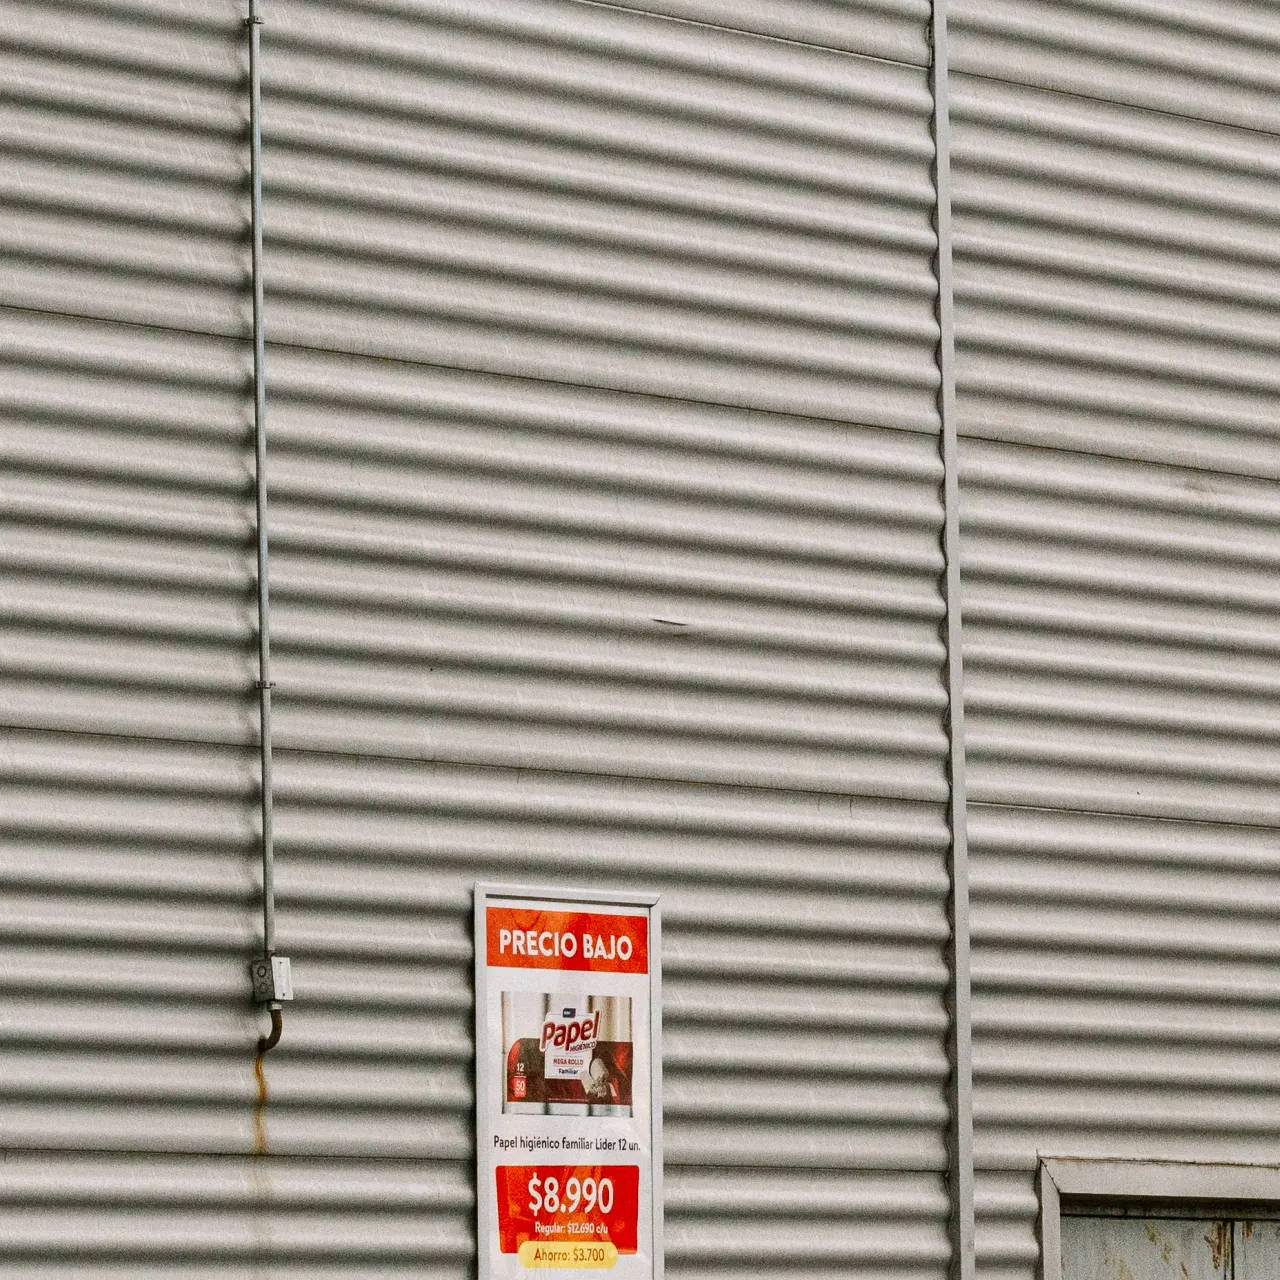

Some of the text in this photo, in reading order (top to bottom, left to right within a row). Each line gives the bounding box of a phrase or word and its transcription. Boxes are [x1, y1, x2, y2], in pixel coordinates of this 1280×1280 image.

[499, 929, 633, 961] PRECIO BAJO
[542, 1010, 600, 1051] Papel
[517, 1063, 525, 1072] 12
[493, 1135, 641, 1153] Papel higiénico familiar Lider 12 un.
[528, 1172, 614, 1216] $8.990
[535, 1222, 608, 1236] Regular: $12.690 c/u
[534, 1248, 605, 1262] Ahorro: $3.700
